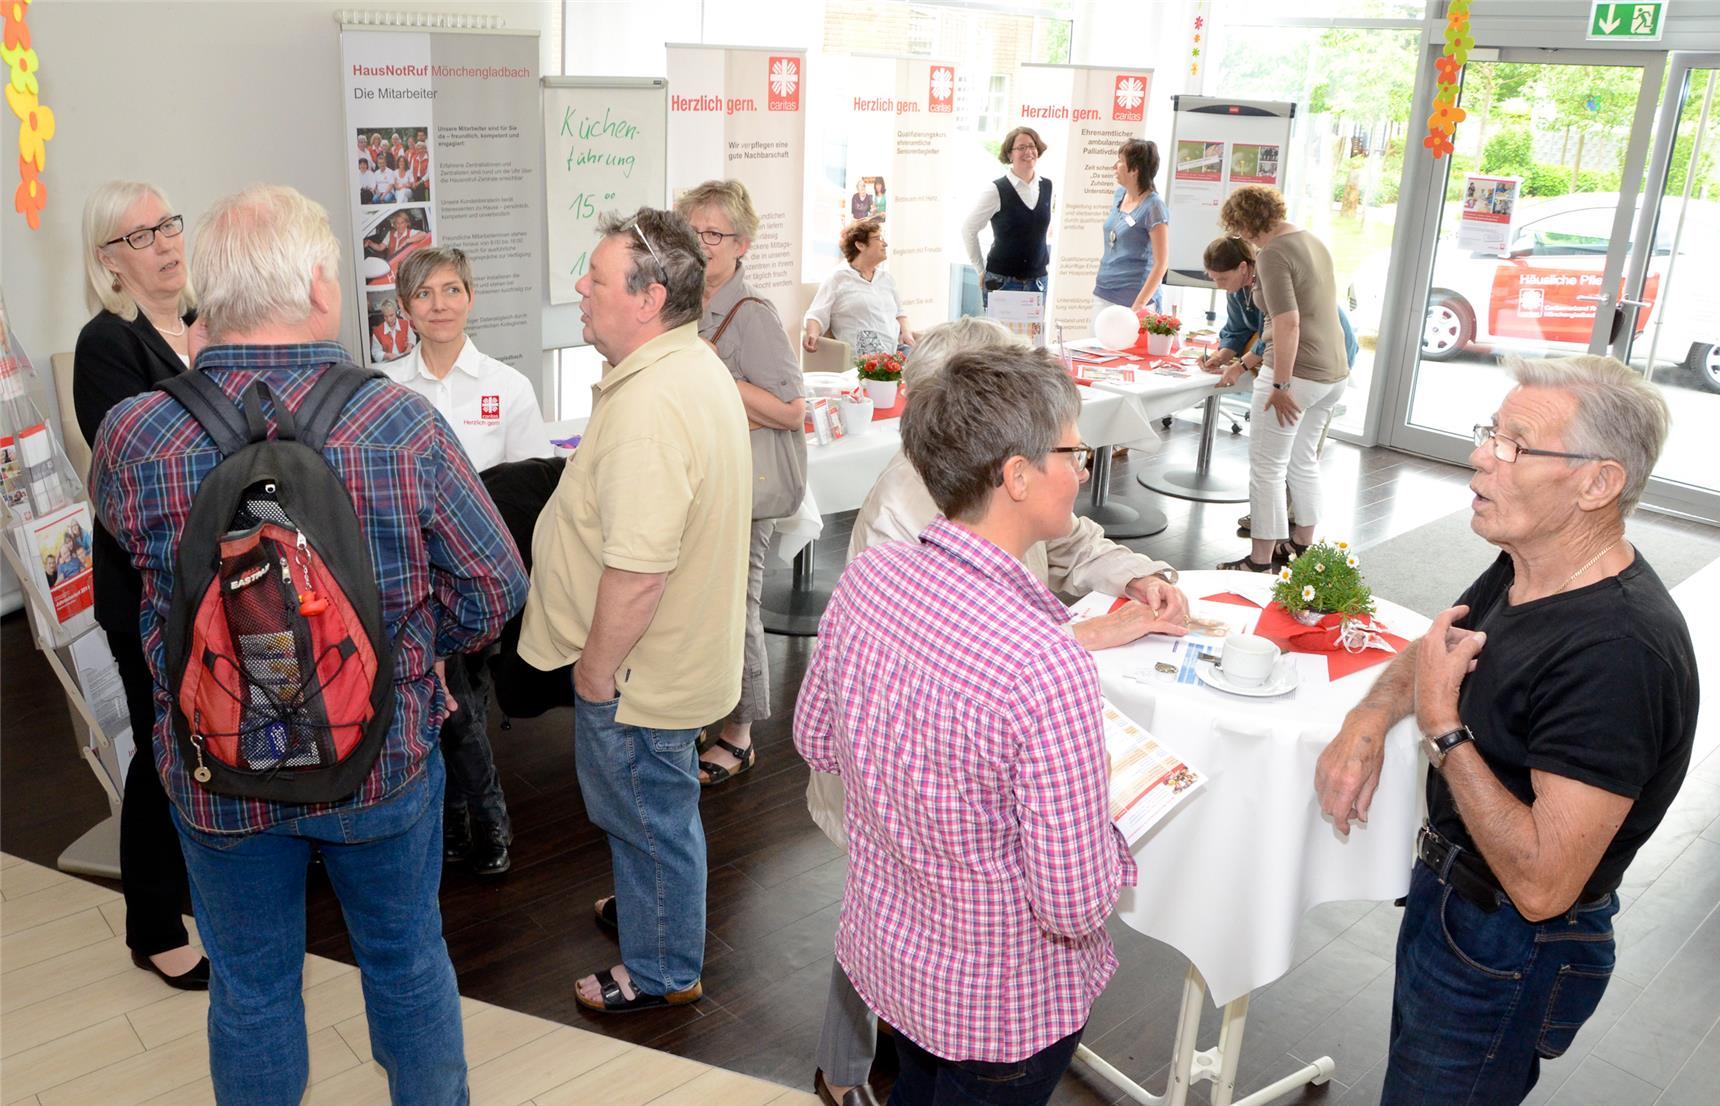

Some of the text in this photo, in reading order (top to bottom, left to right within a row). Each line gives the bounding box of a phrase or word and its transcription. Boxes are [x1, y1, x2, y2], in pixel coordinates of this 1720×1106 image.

[353, 64, 530, 80] HausNotRuf Mönchengladbach
[354, 88, 438, 99] Die Mitarbeiter
[671, 95, 758, 115] Herzlich gern.
[770, 101, 797, 111] caritas
[853, 96, 921, 115] Herzlich gern.
[1021, 104, 1102, 122] Herzlich gern.
[1114, 111, 1141, 120] caritas
[1081, 128, 1133, 137] Ehrenamtlicher
[728, 141, 739, 149] Wir
[775, 141, 788, 149] eine
[728, 151, 789, 161] gute Nachbarschaft
[1083, 147, 1120, 155] Palliativdie
[1520, 273, 1577, 286] Häusliche
